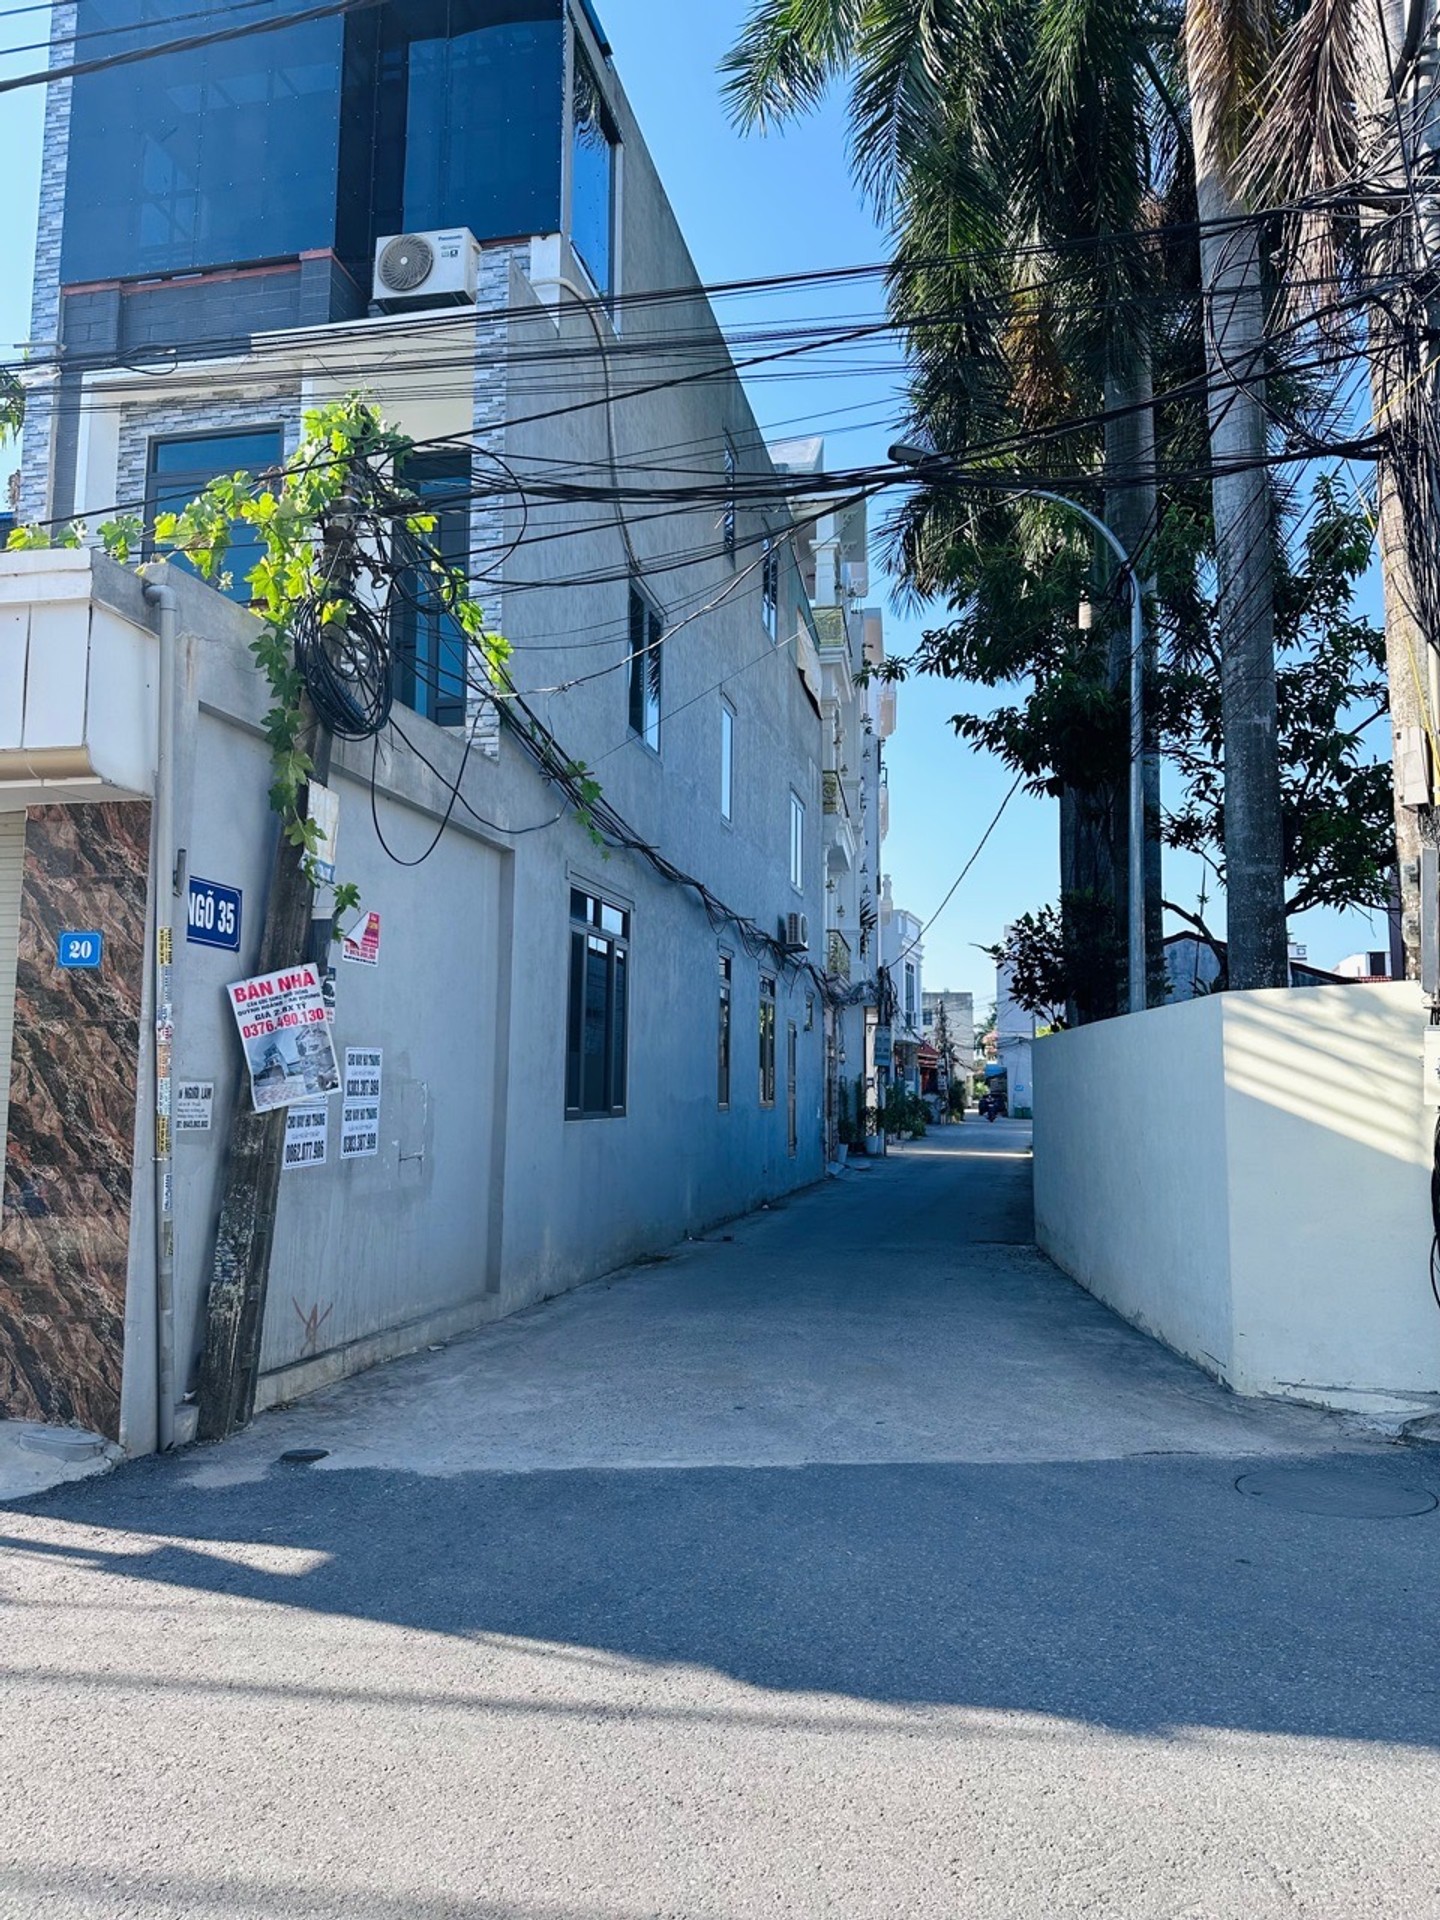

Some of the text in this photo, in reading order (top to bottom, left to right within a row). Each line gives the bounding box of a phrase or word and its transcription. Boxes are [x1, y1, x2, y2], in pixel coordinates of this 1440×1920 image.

[188, 890, 235, 935] NGÕ 35
[69, 940, 92, 959] 20
[233, 969, 316, 1003] BÁN NHÀ
[242, 1007, 325, 1039] 0376.490.130
[254, 1010, 271, 1021] GIÁ
